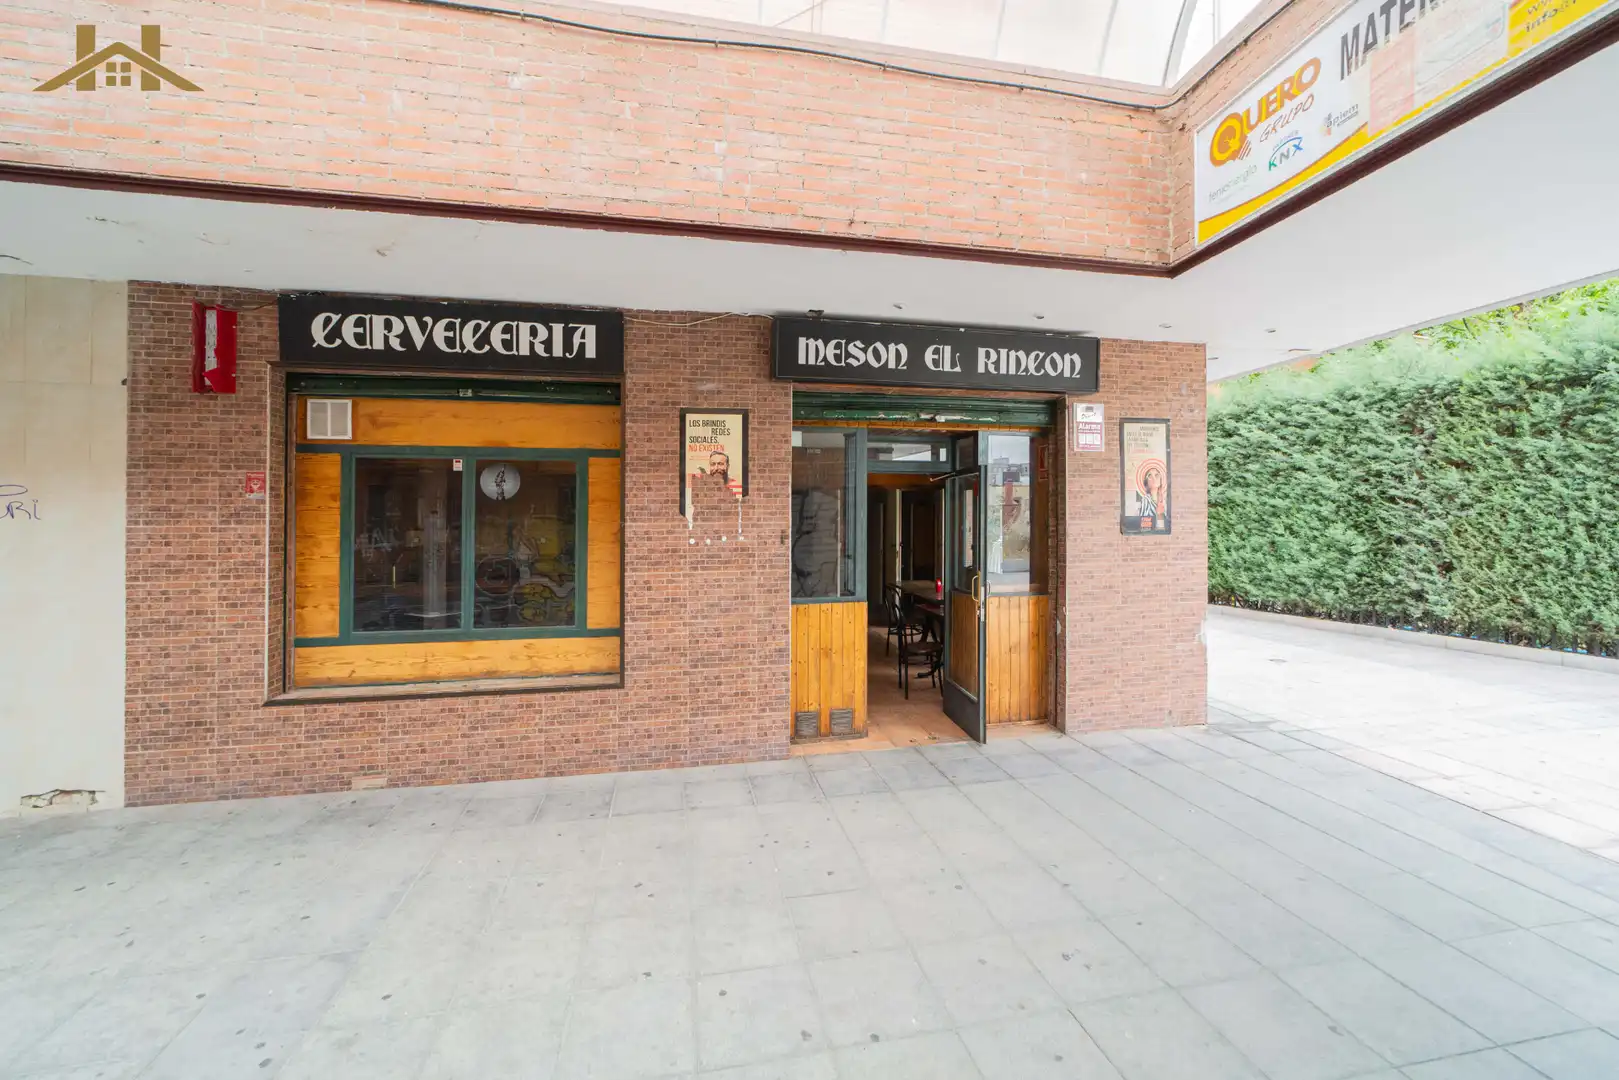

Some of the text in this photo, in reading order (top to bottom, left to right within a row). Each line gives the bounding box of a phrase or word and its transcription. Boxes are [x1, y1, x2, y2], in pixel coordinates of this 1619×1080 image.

[1210, 57, 1321, 168] QUERO
[1260, 93, 1315, 142] GRUPO
[1268, 136, 1304, 171] KNX
[310, 312, 597, 359] CERVECERIA
[798, 337, 1082, 378] MESON EL RINCON
[711, 428, 731, 436] REDES
